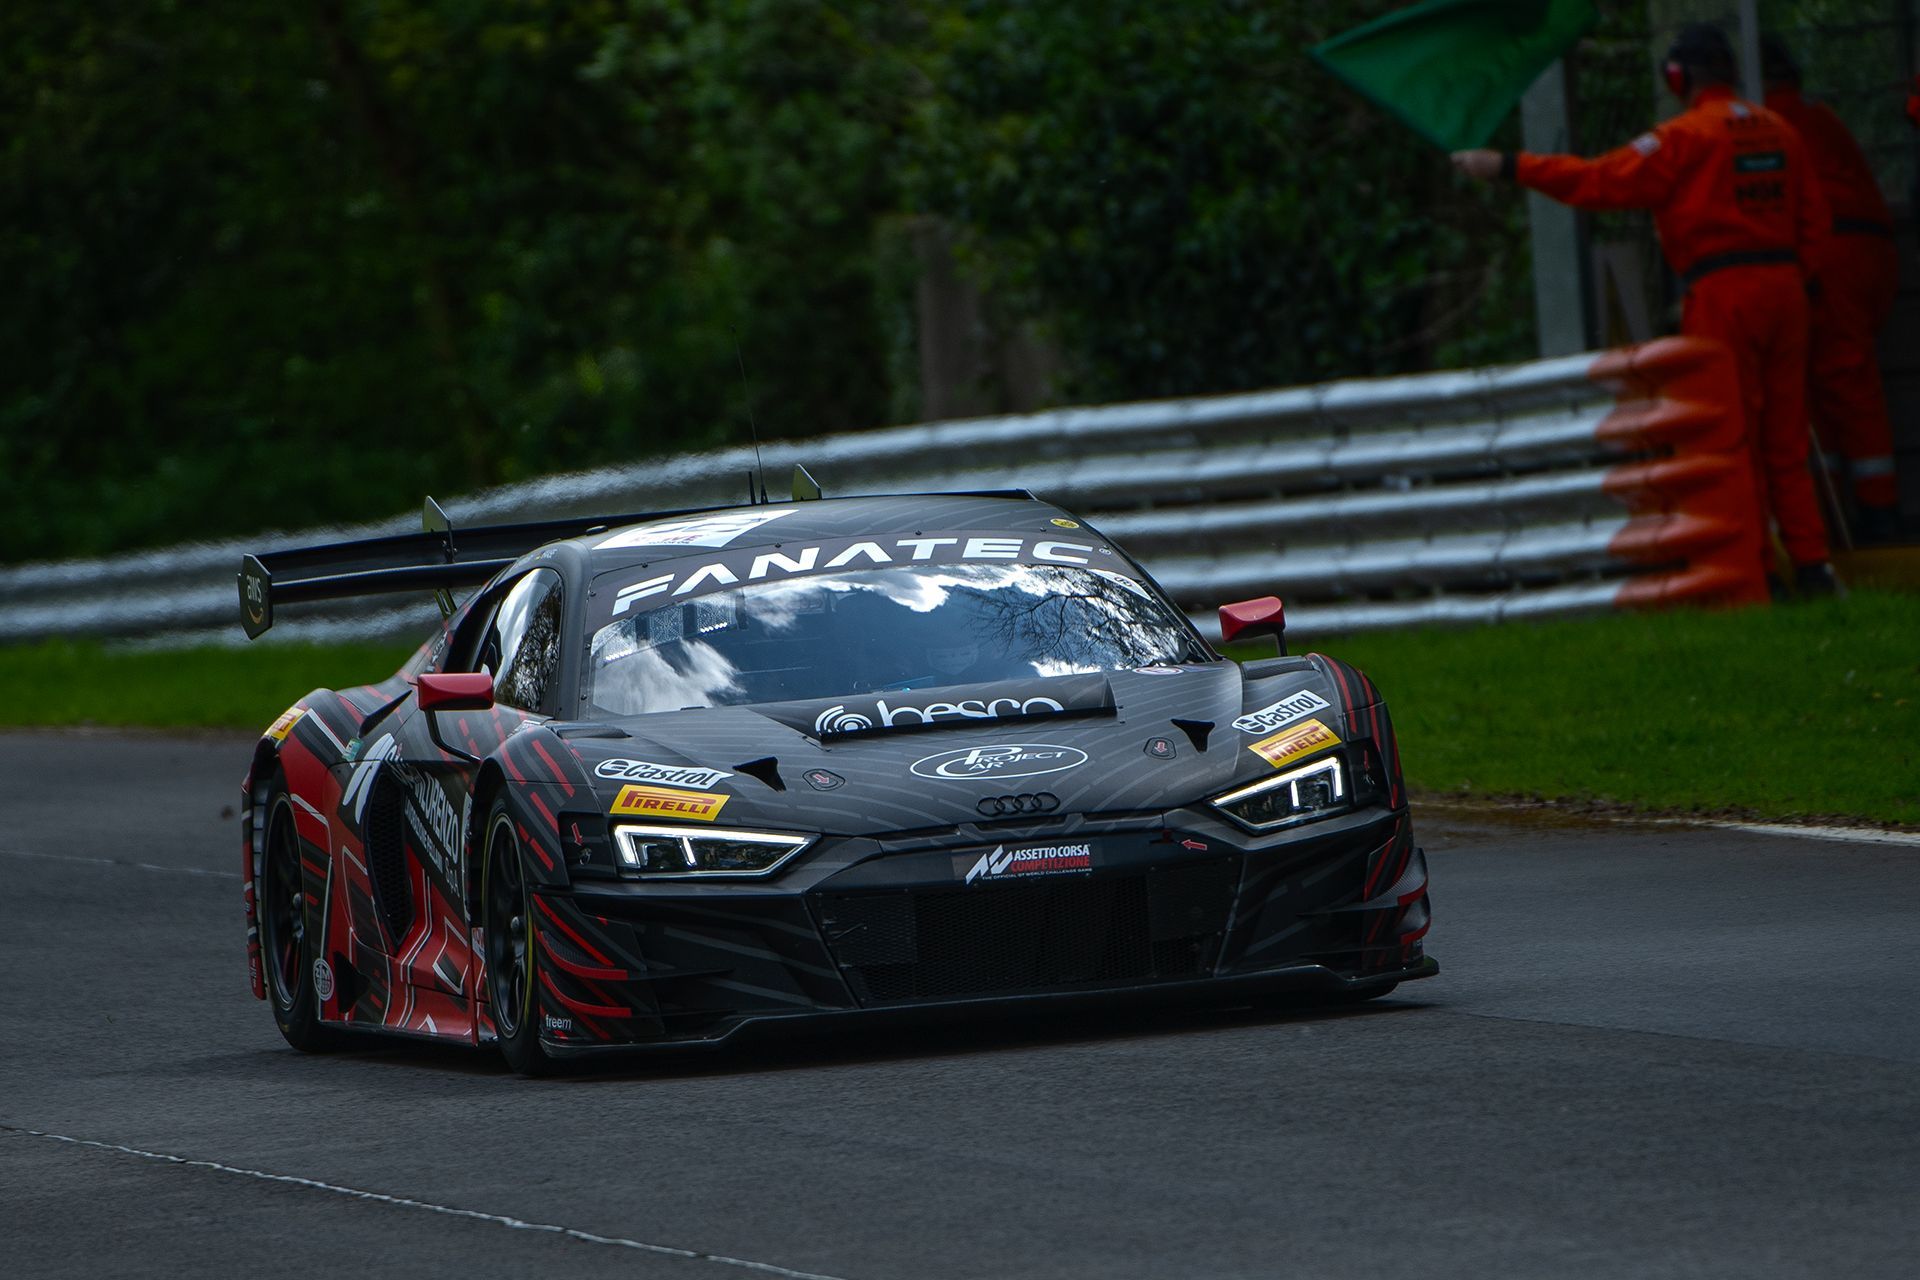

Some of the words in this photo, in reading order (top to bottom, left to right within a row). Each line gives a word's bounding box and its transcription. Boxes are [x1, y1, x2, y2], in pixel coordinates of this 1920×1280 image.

[611, 537, 1095, 616] FANATEC
[1253, 694, 1323, 726] Castrol
[1260, 725, 1330, 760] PIRELLI
[964, 746, 1067, 765] PROJECT
[623, 764, 718, 786] Castrol
[621, 790, 718, 815] PIRELLI
[1013, 847, 1057, 861] ASSETTO
[1057, 844, 1090, 858] CORSA
[1010, 857, 1090, 872] COMPETIZIONE
[545, 1014, 572, 1029] freem
